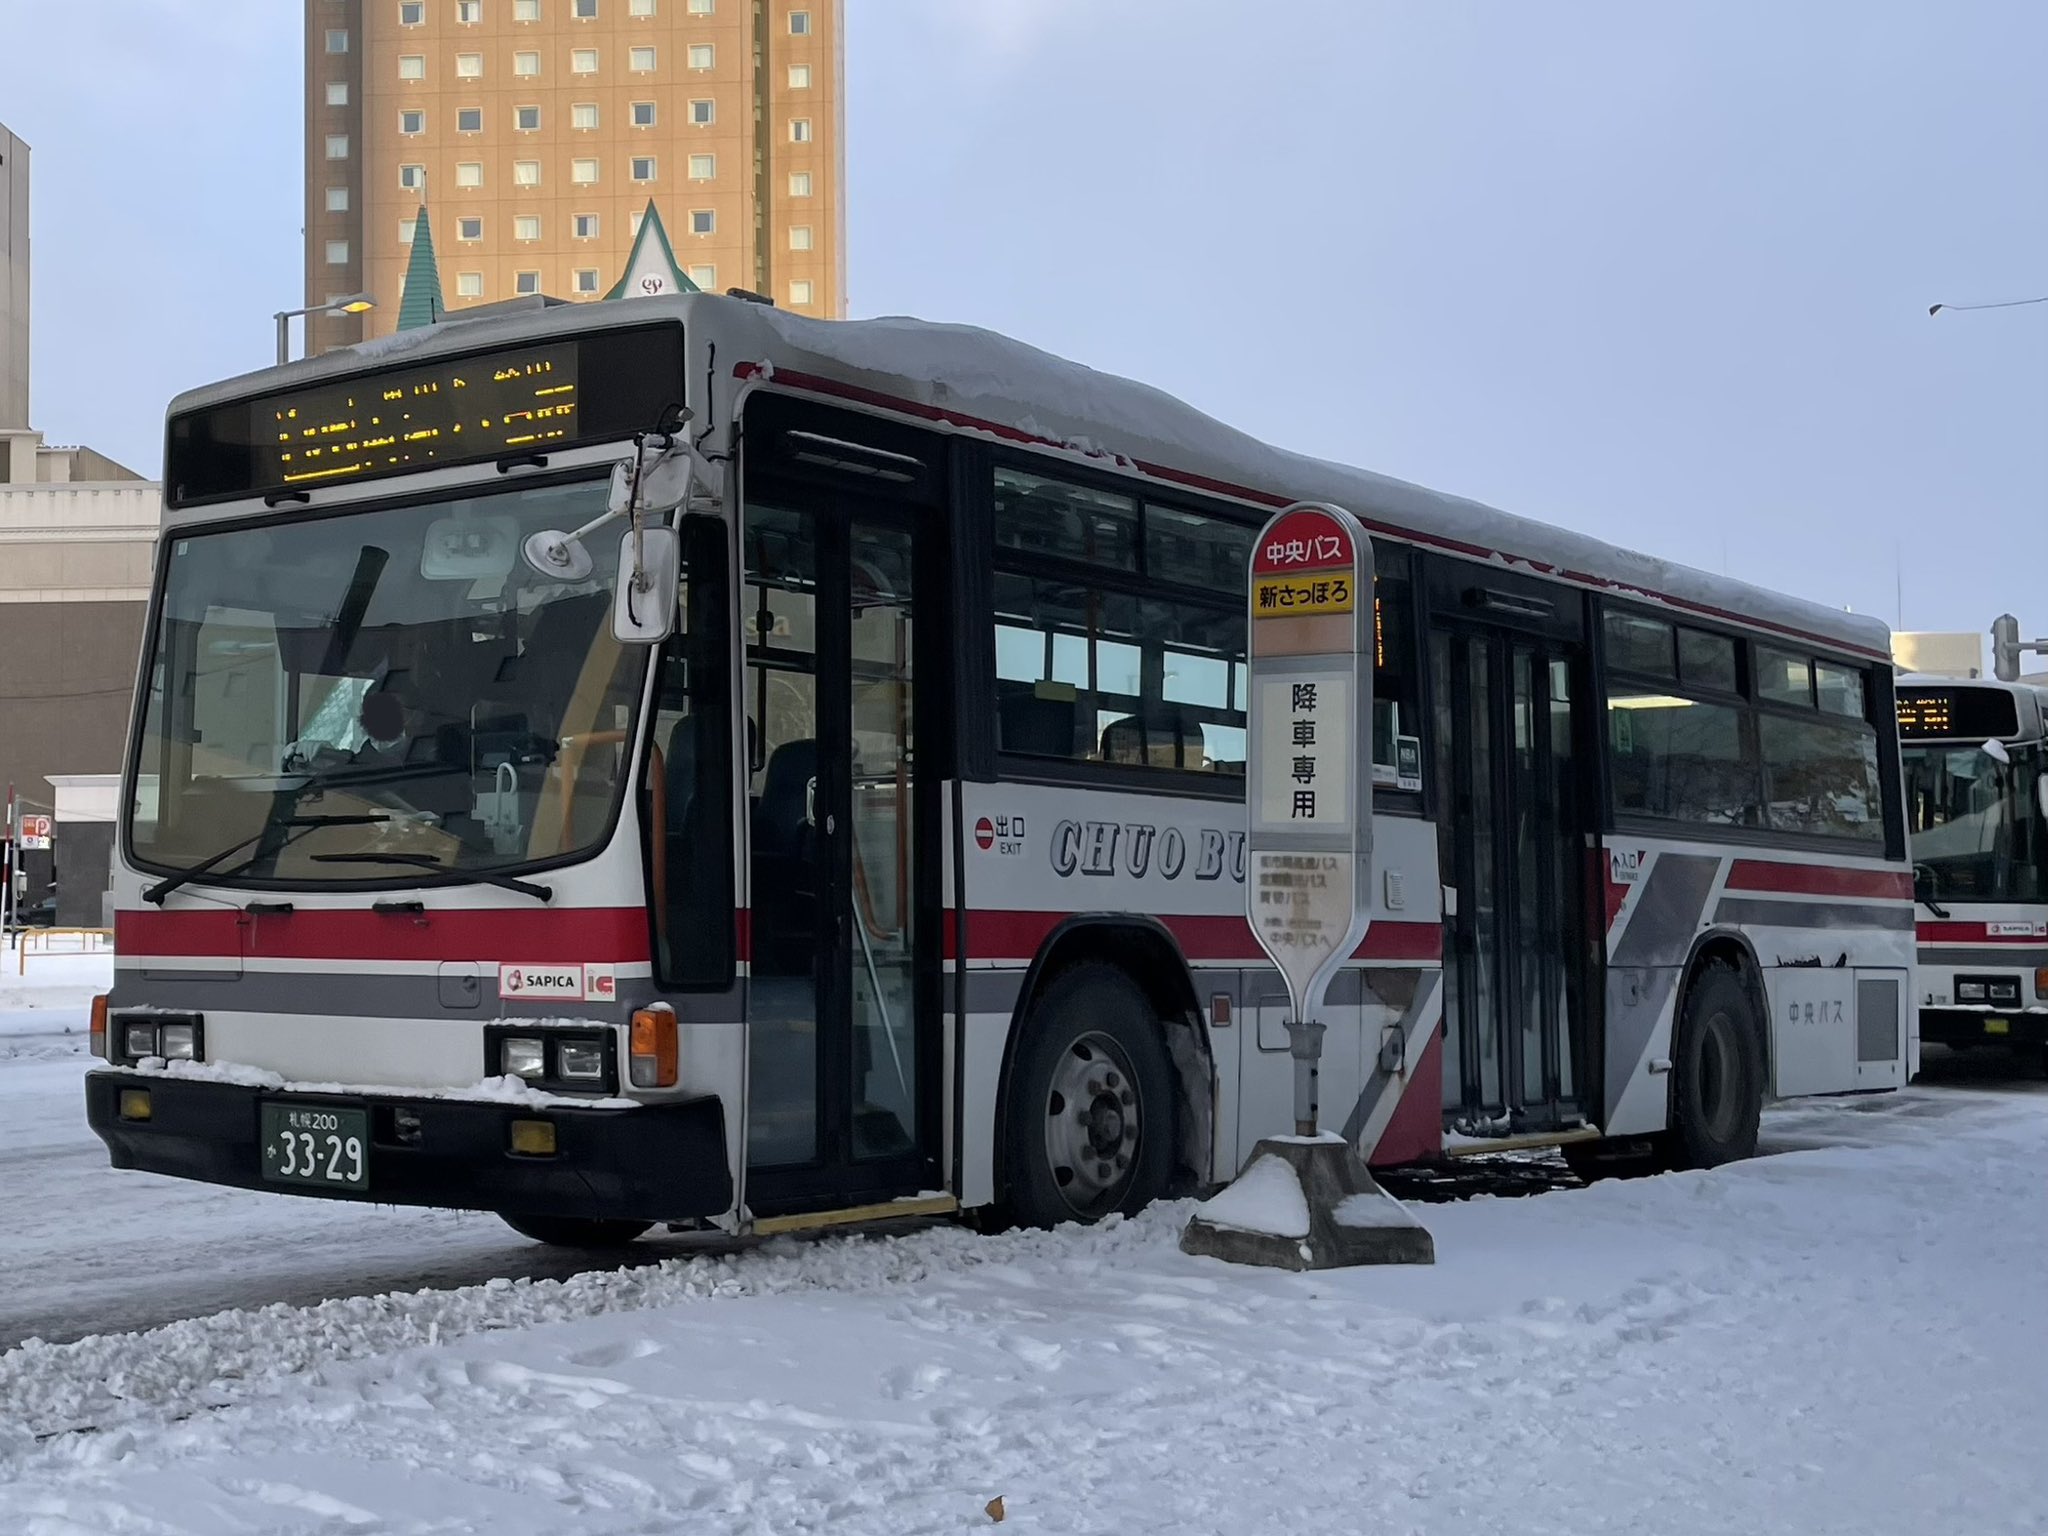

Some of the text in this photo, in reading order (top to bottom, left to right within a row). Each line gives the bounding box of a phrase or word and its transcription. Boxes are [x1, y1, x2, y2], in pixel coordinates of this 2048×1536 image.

[1266, 536, 1342, 565] 中央バス
[1259, 580, 1349, 609] 新さっぽろ
[1291, 683, 1318, 819] 降車専用
[996, 816, 1024, 838] 出口
[1000, 842, 1022, 855] EXIT
[1050, 819, 1246, 884] CHUO BU
[526, 975, 574, 987] SAPICA
[1789, 1000, 1843, 1026] 中央バス
